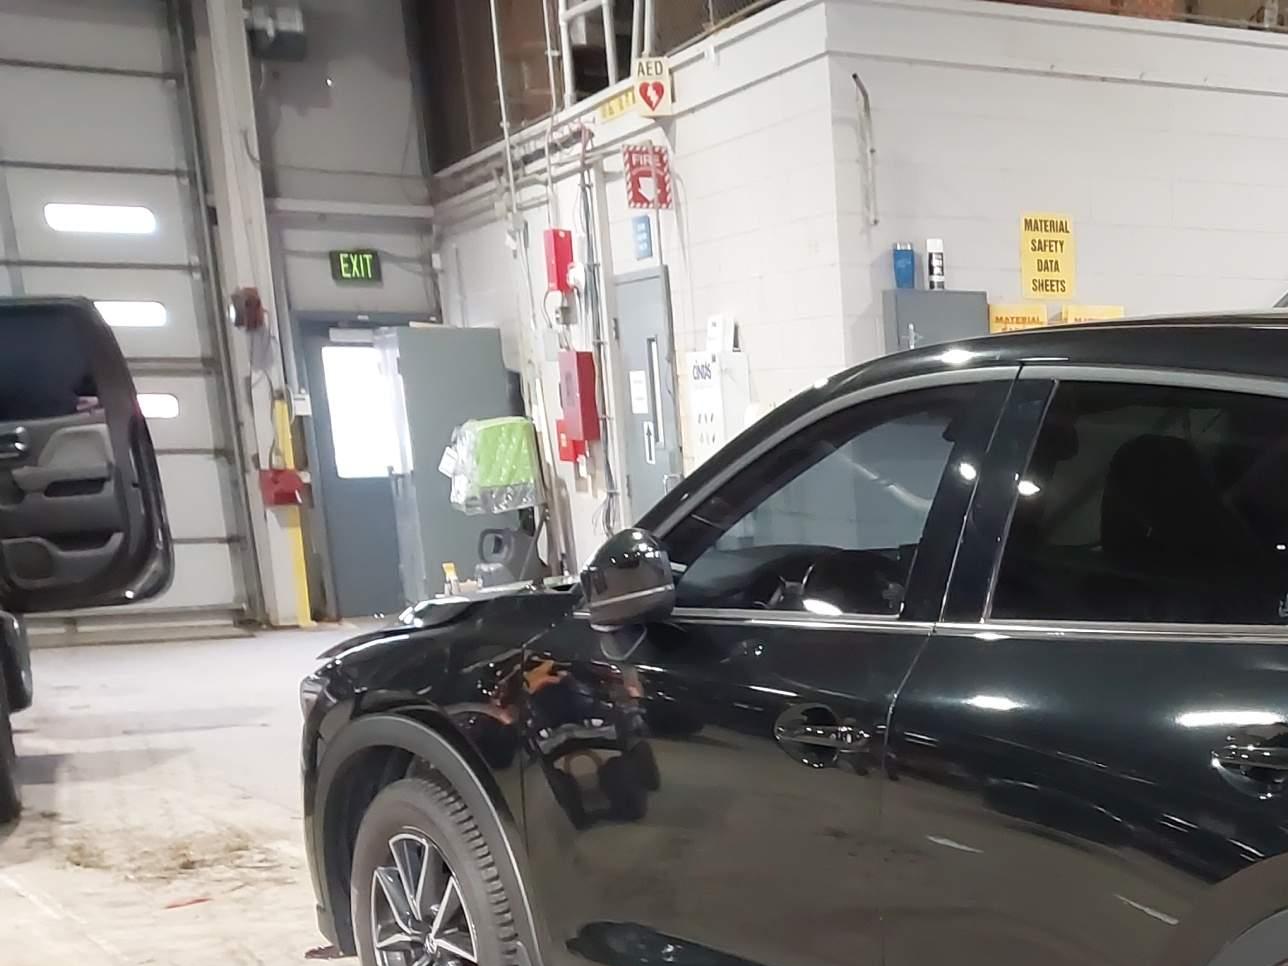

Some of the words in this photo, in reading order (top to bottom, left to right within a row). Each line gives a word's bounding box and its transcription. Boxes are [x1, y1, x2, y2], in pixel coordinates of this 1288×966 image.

[637, 60, 664, 76] AED
[631, 153, 662, 167] FIRE
[1023, 218, 1071, 234] MATERIAL
[1030, 238, 1065, 253] SAFETY
[339, 253, 373, 279] EXIT
[1036, 258, 1061, 273] DATA
[1031, 278, 1066, 293] SHEETS
[994, 314, 1043, 325] MATERIAL
